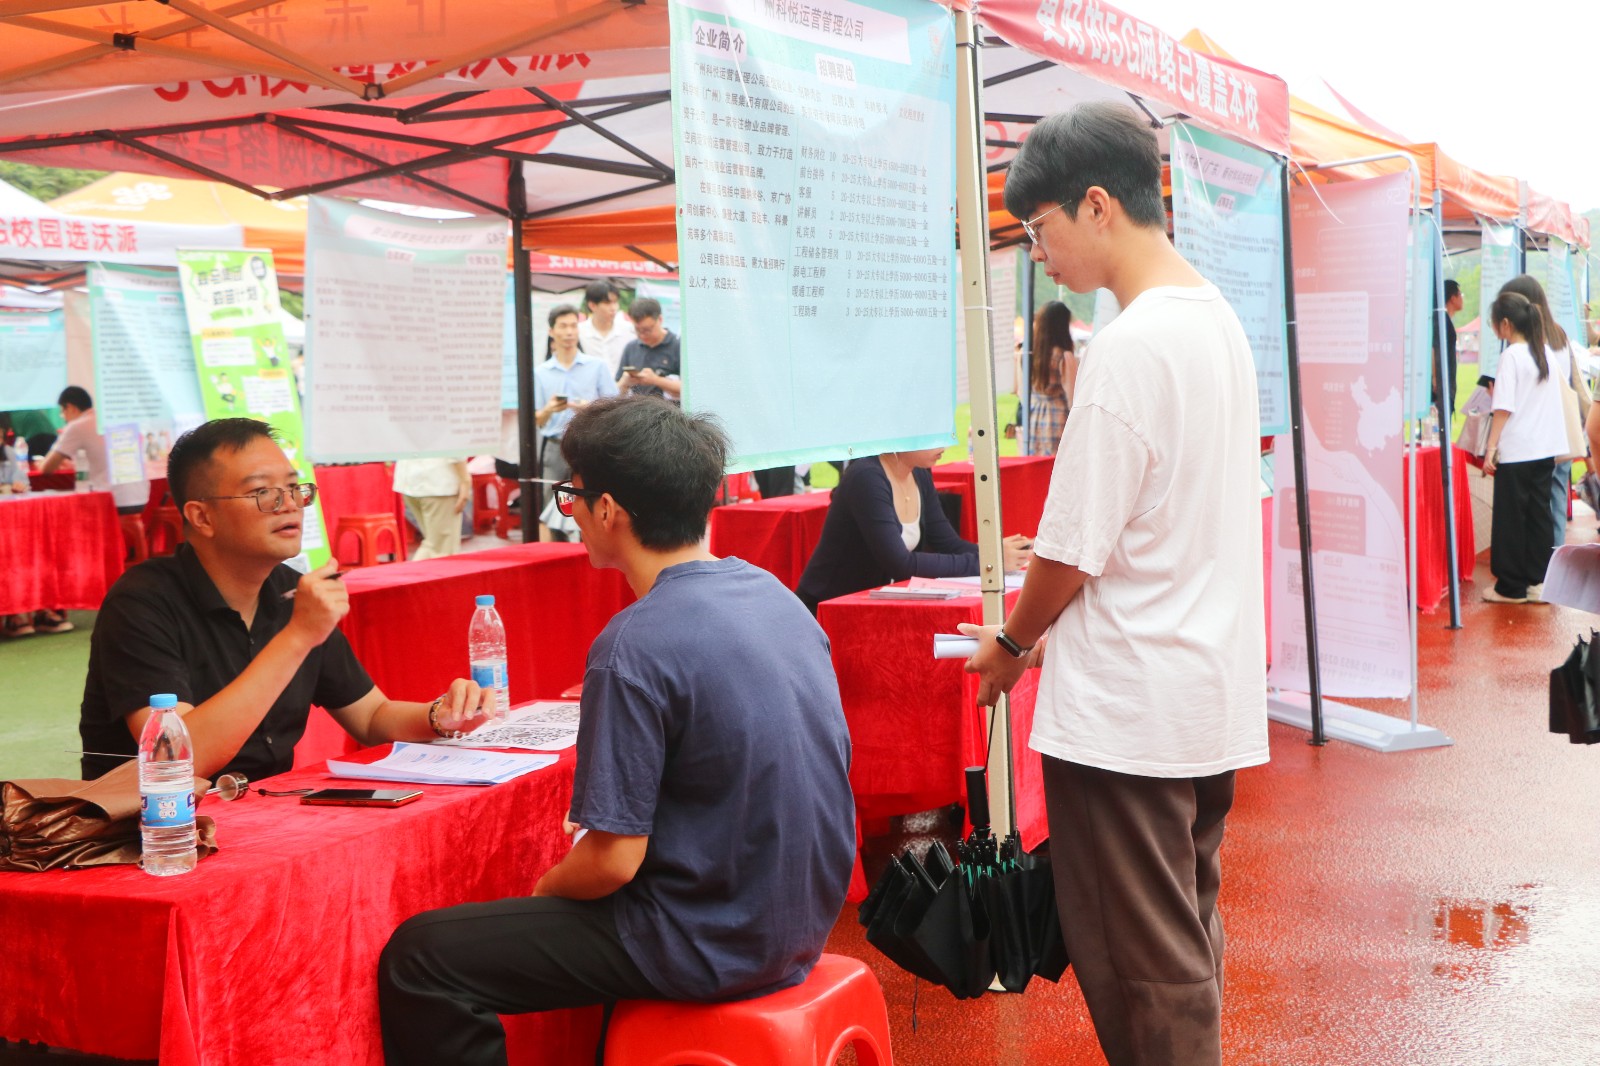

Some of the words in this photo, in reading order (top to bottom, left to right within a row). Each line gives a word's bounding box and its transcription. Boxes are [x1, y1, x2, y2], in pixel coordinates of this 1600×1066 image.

[694, 25, 746, 54] 企业简介
[1036, 0, 1260, 134] 更好的5G网络已覆盖本校
